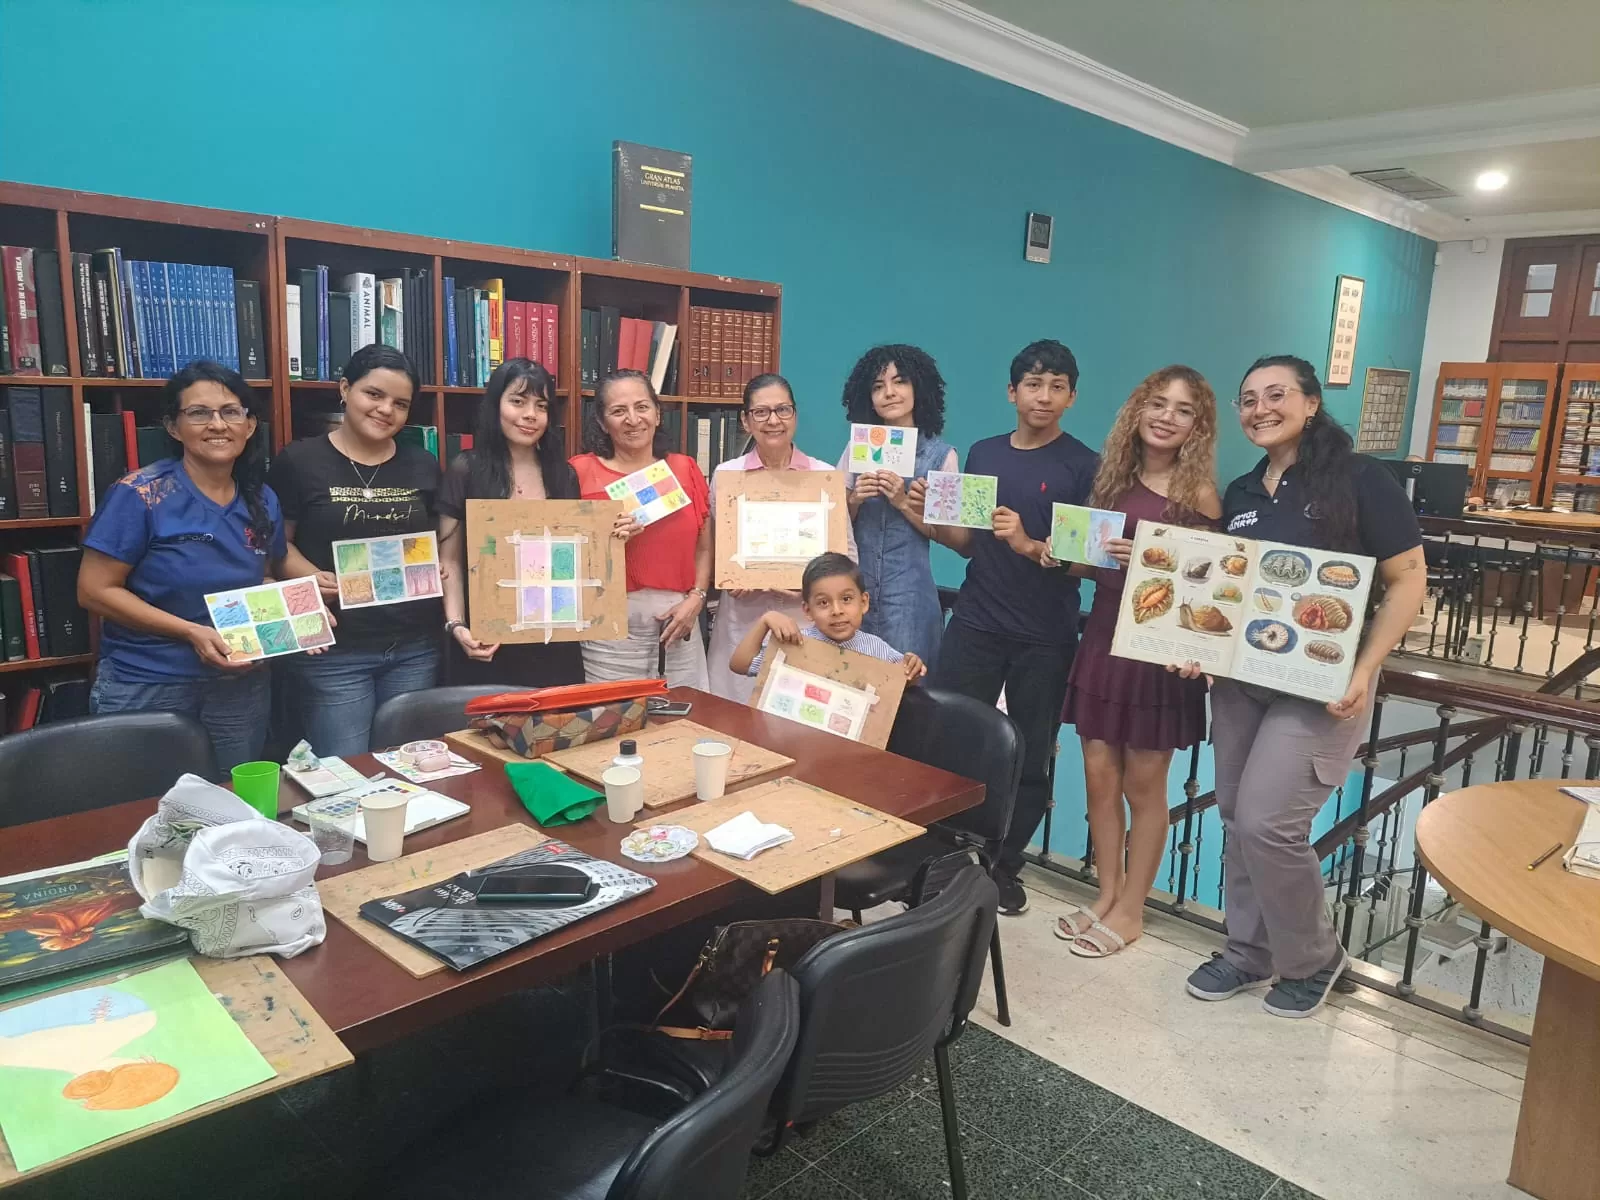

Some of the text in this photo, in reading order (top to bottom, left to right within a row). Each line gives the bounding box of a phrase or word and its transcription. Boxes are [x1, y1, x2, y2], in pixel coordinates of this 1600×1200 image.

[644, 172, 681, 185] GRAN ATLAS
[17, 283, 25, 291] LA
[363, 291, 371, 328] ANIMAL
[22, 884, 77, 900] ONDINA
